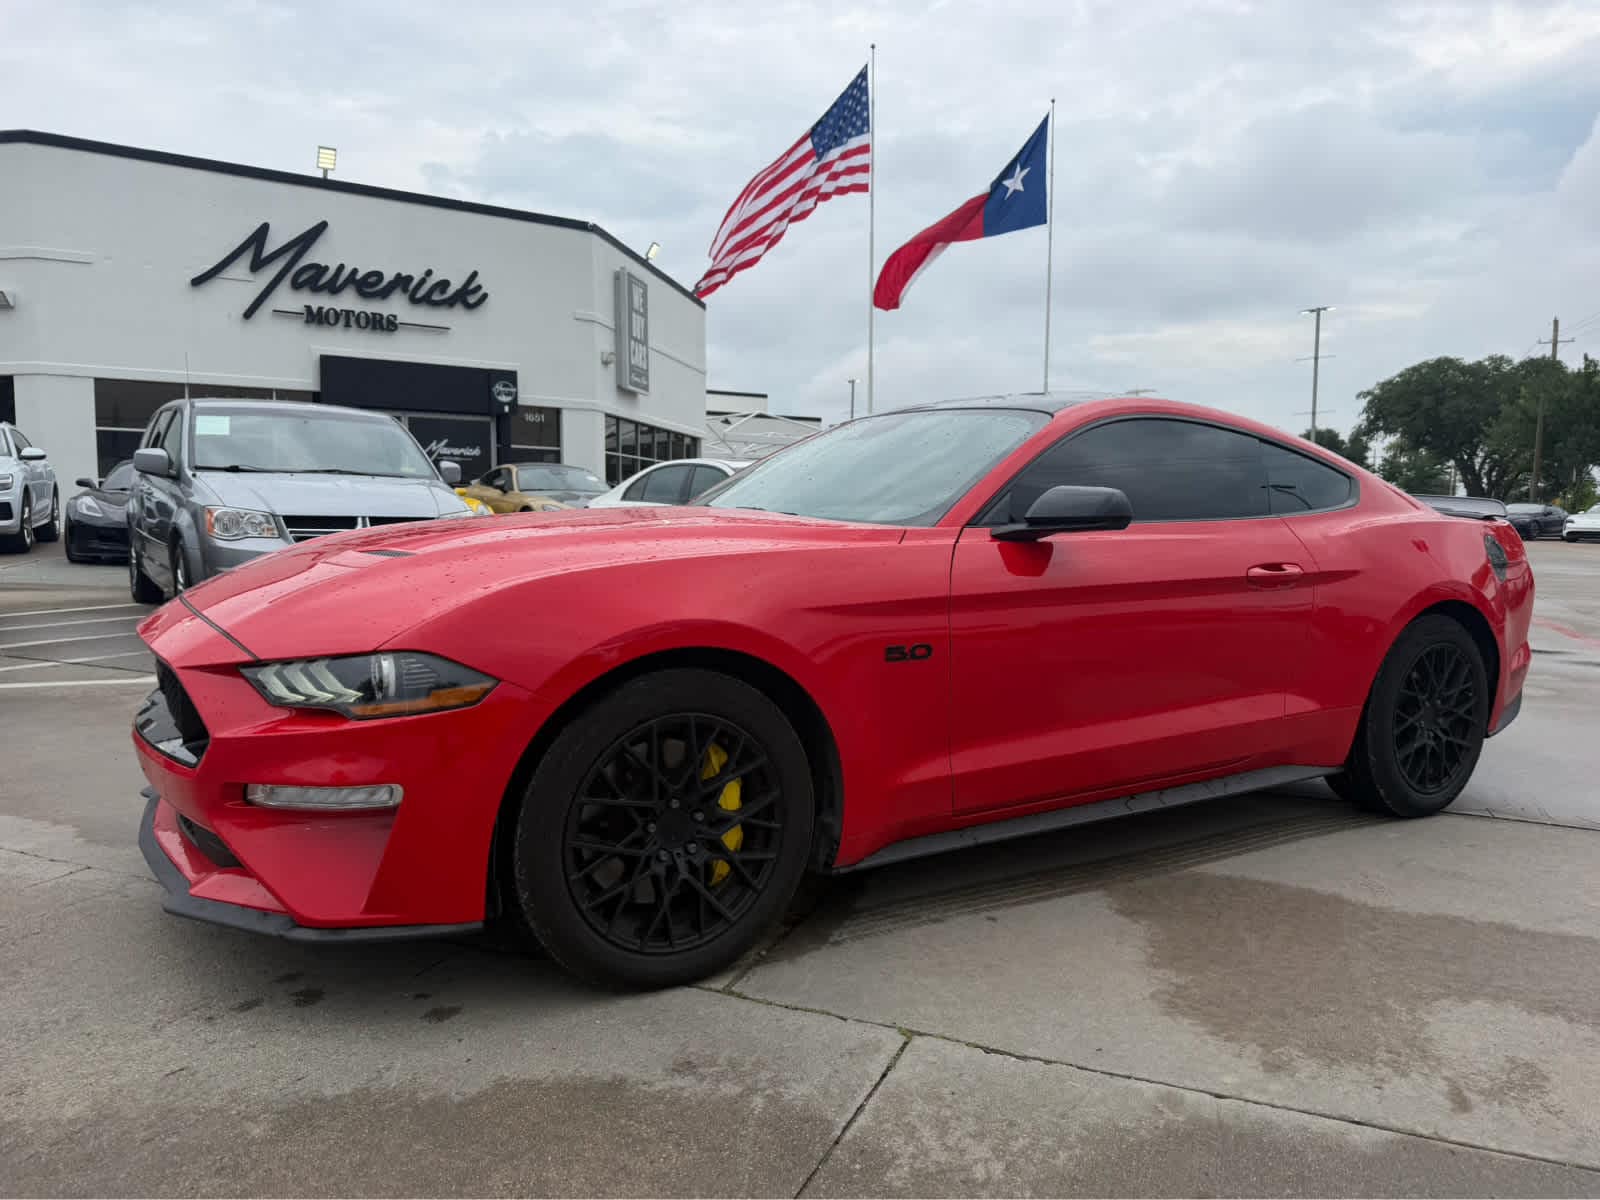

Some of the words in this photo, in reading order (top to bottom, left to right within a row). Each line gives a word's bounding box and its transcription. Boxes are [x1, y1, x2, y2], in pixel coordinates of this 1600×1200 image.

[190, 220, 489, 320] Maverick
[303, 305, 398, 332] MOTORS
[885, 644, 933, 663] 5.0
